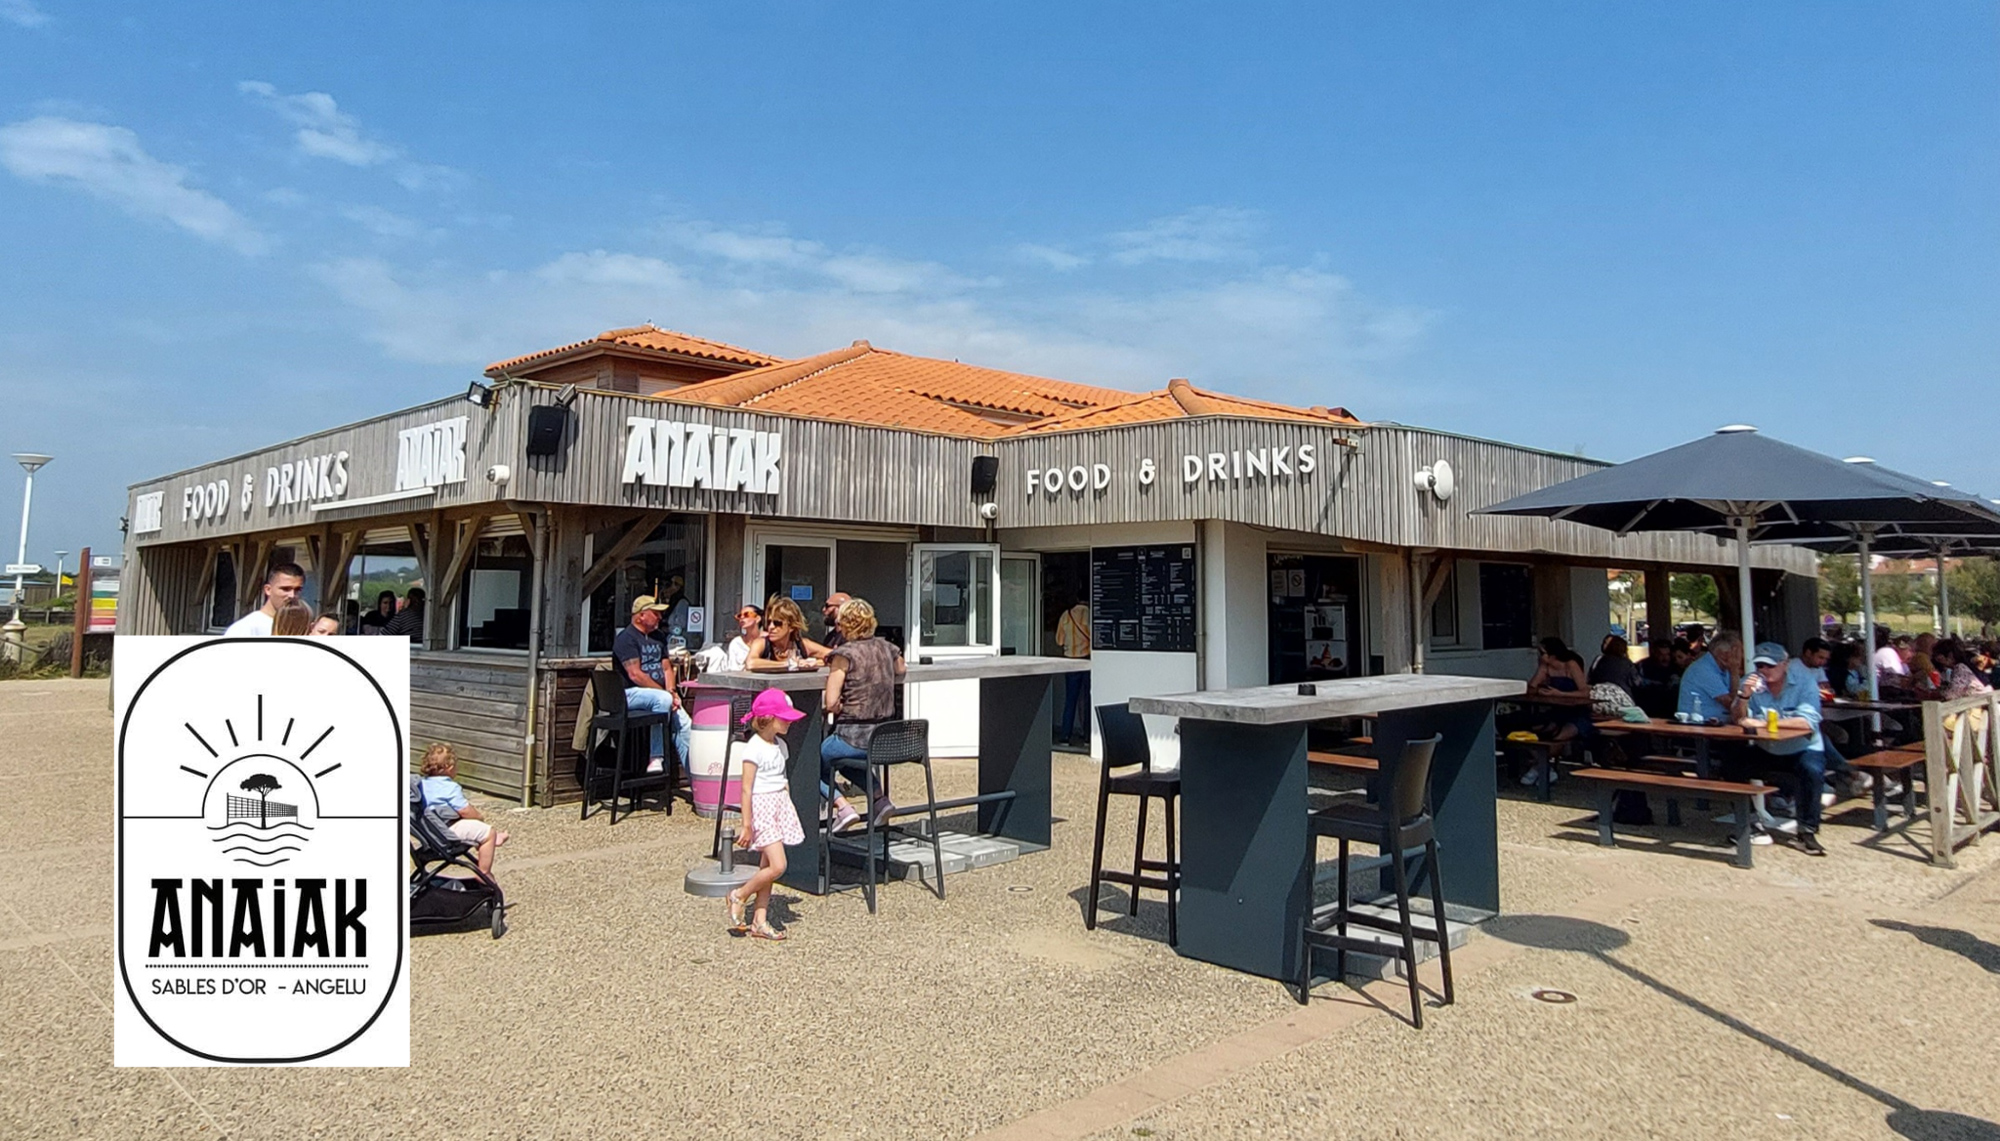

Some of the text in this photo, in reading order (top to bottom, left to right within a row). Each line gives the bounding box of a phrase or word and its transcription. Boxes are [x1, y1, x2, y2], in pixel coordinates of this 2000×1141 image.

[182, 479, 230, 522] FOOD
[241, 474, 254, 512] &
[265, 450, 349, 507] DRINKS
[1026, 444, 1316, 495] FOOD & DRINKS
